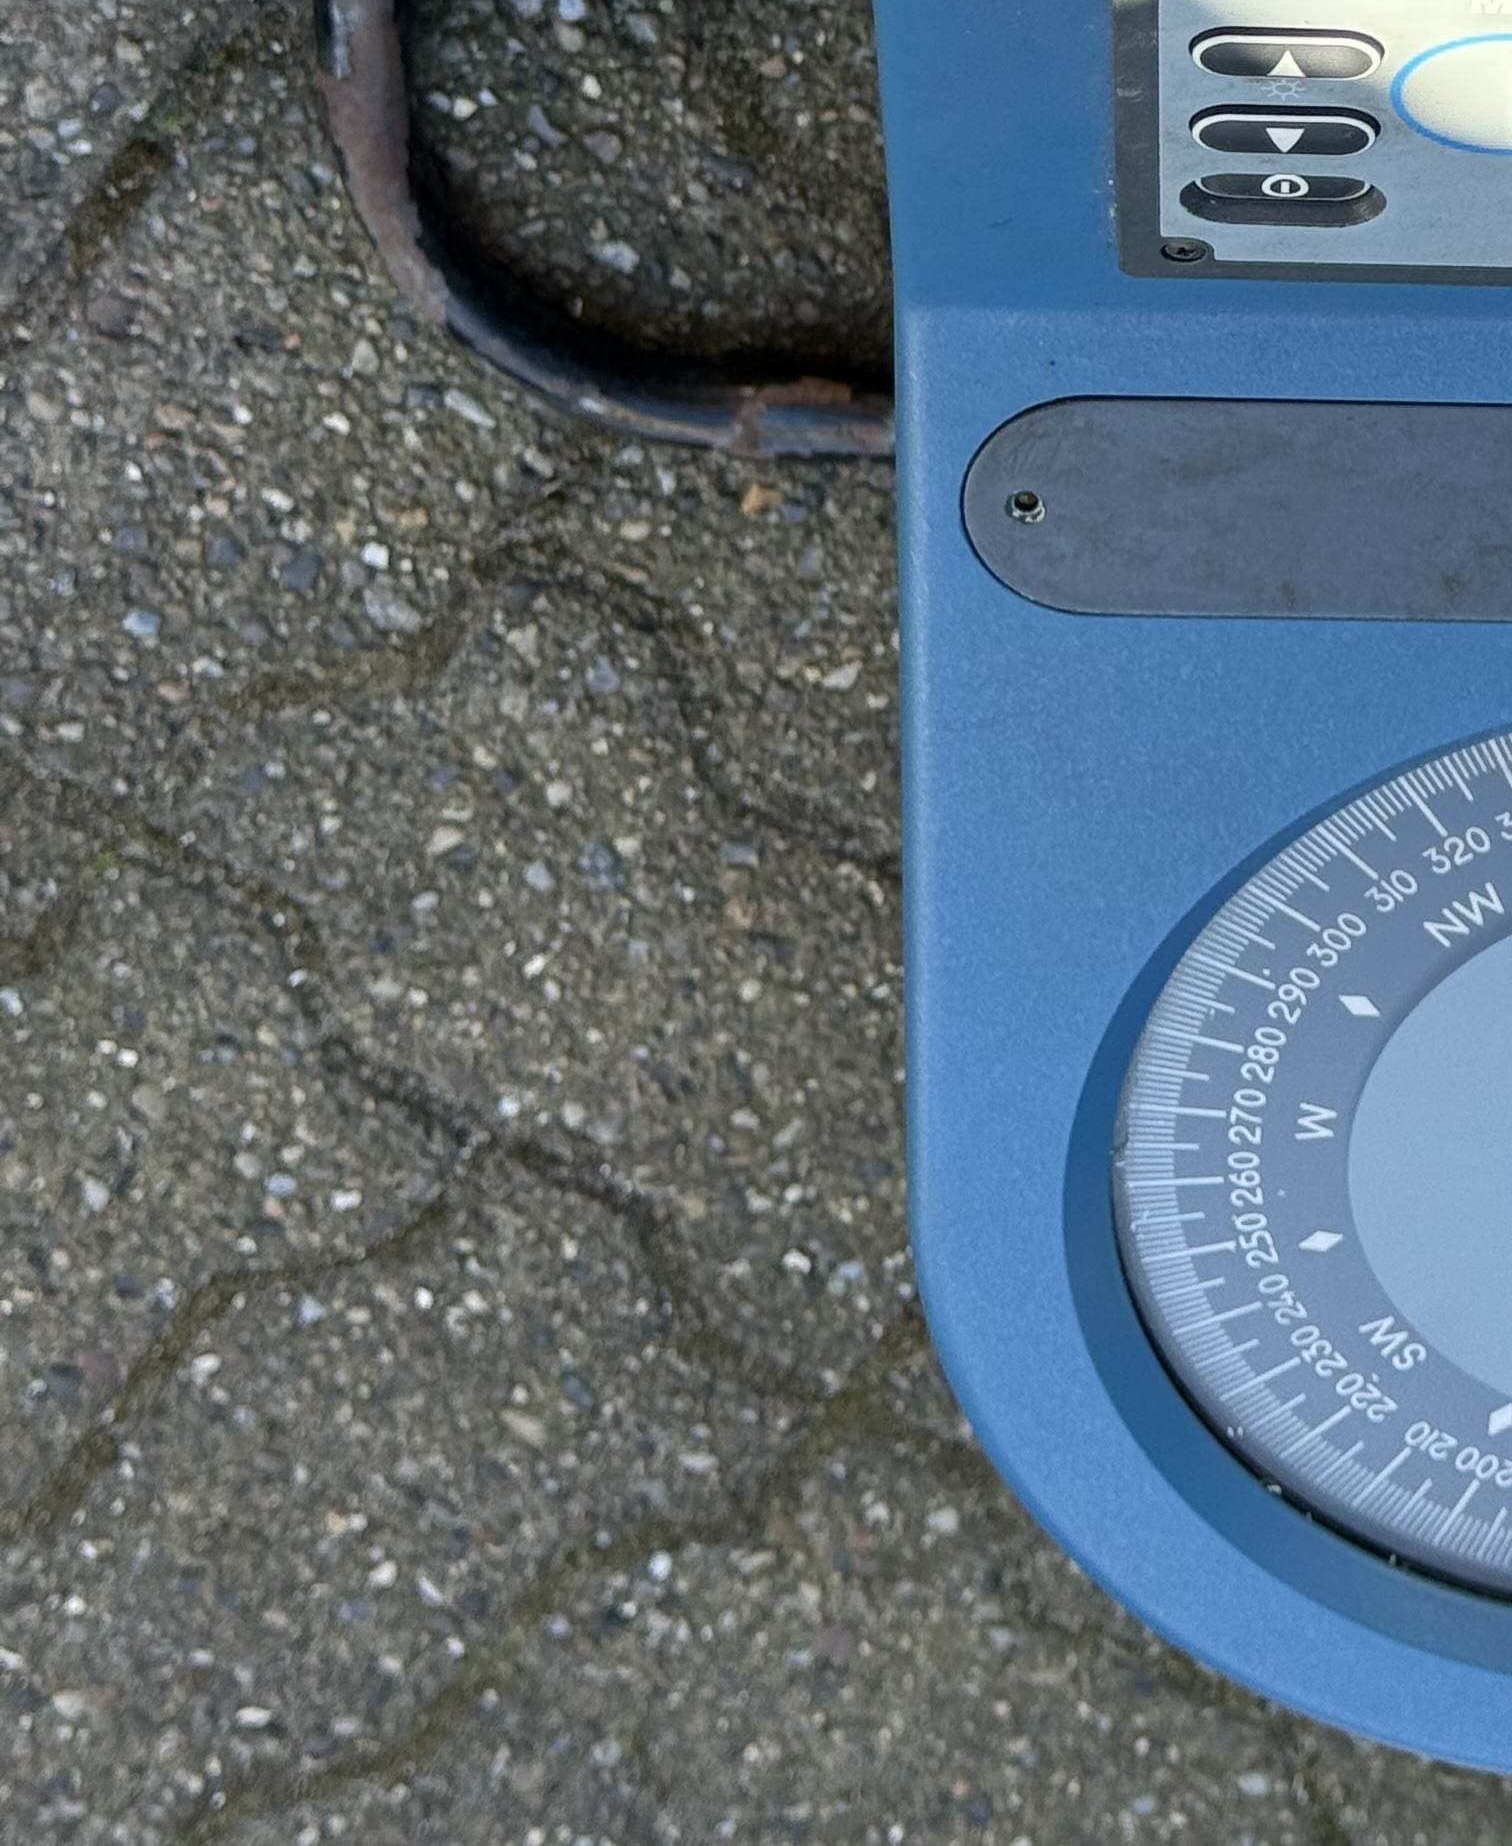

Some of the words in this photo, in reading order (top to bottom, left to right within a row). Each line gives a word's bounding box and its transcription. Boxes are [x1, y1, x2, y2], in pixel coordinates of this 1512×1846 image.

[1422, 826, 1492, 874] 320
[1364, 868, 1419, 914] 310
[1422, 881, 1506, 948] NW
[1307, 911, 1368, 967] 300
[1267, 967, 1321, 1025] 290
[1239, 1026, 1288, 1085] 280
[1227, 1089, 1268, 1145] 270
[1295, 1102, 1338, 1140] W
[1227, 1150, 1263, 1208] 260
[1233, 1212, 1280, 1268] 250
[1258, 1272, 1308, 1325] 240
[1290, 1324, 1348, 1378] 230
[1359, 1314, 1427, 1371] SW
[1336, 1373, 1398, 1422] 220
[1404, 1419, 1459, 1460] 210
